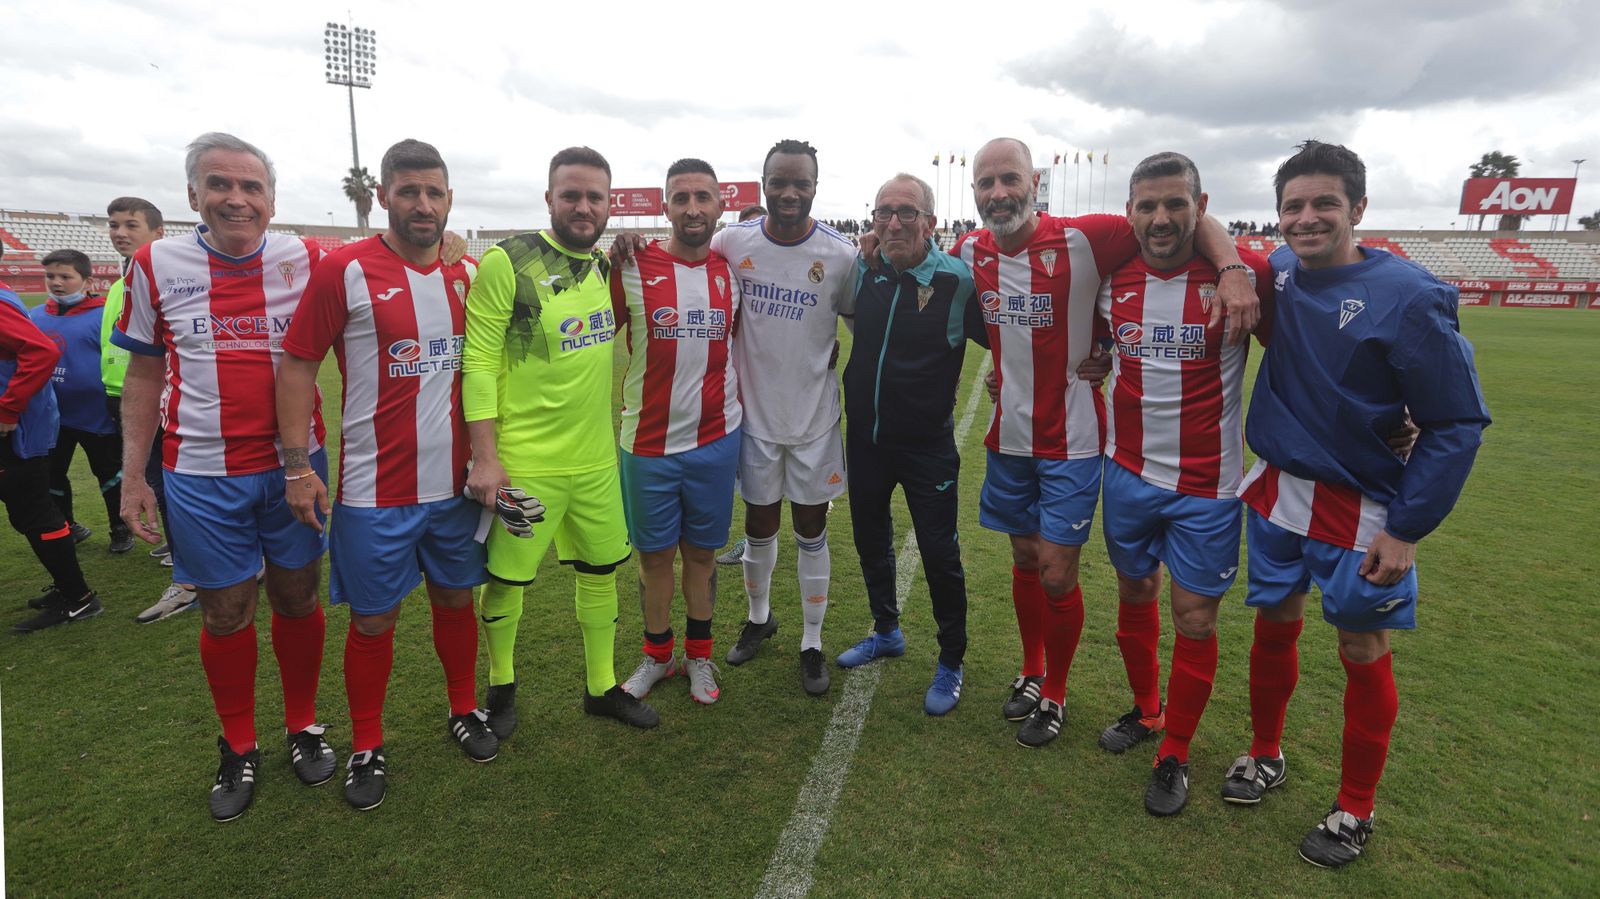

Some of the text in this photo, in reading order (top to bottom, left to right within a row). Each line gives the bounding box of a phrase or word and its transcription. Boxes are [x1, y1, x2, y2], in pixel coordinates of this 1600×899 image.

[163, 283, 207, 297] Troya
[177, 276, 196, 285] Pepe
[742, 279, 819, 307] Emirates
[751, 299, 804, 321] FLY BETTER
[1008, 294, 1052, 313] 威视
[191, 314, 292, 340] EXCEM
[589, 309, 614, 331] 威视
[687, 309, 725, 326] 威视
[654, 328, 725, 339] NUCTECH
[1152, 325, 1204, 344] 威视
[1119, 344, 1203, 359] NUCTECH
